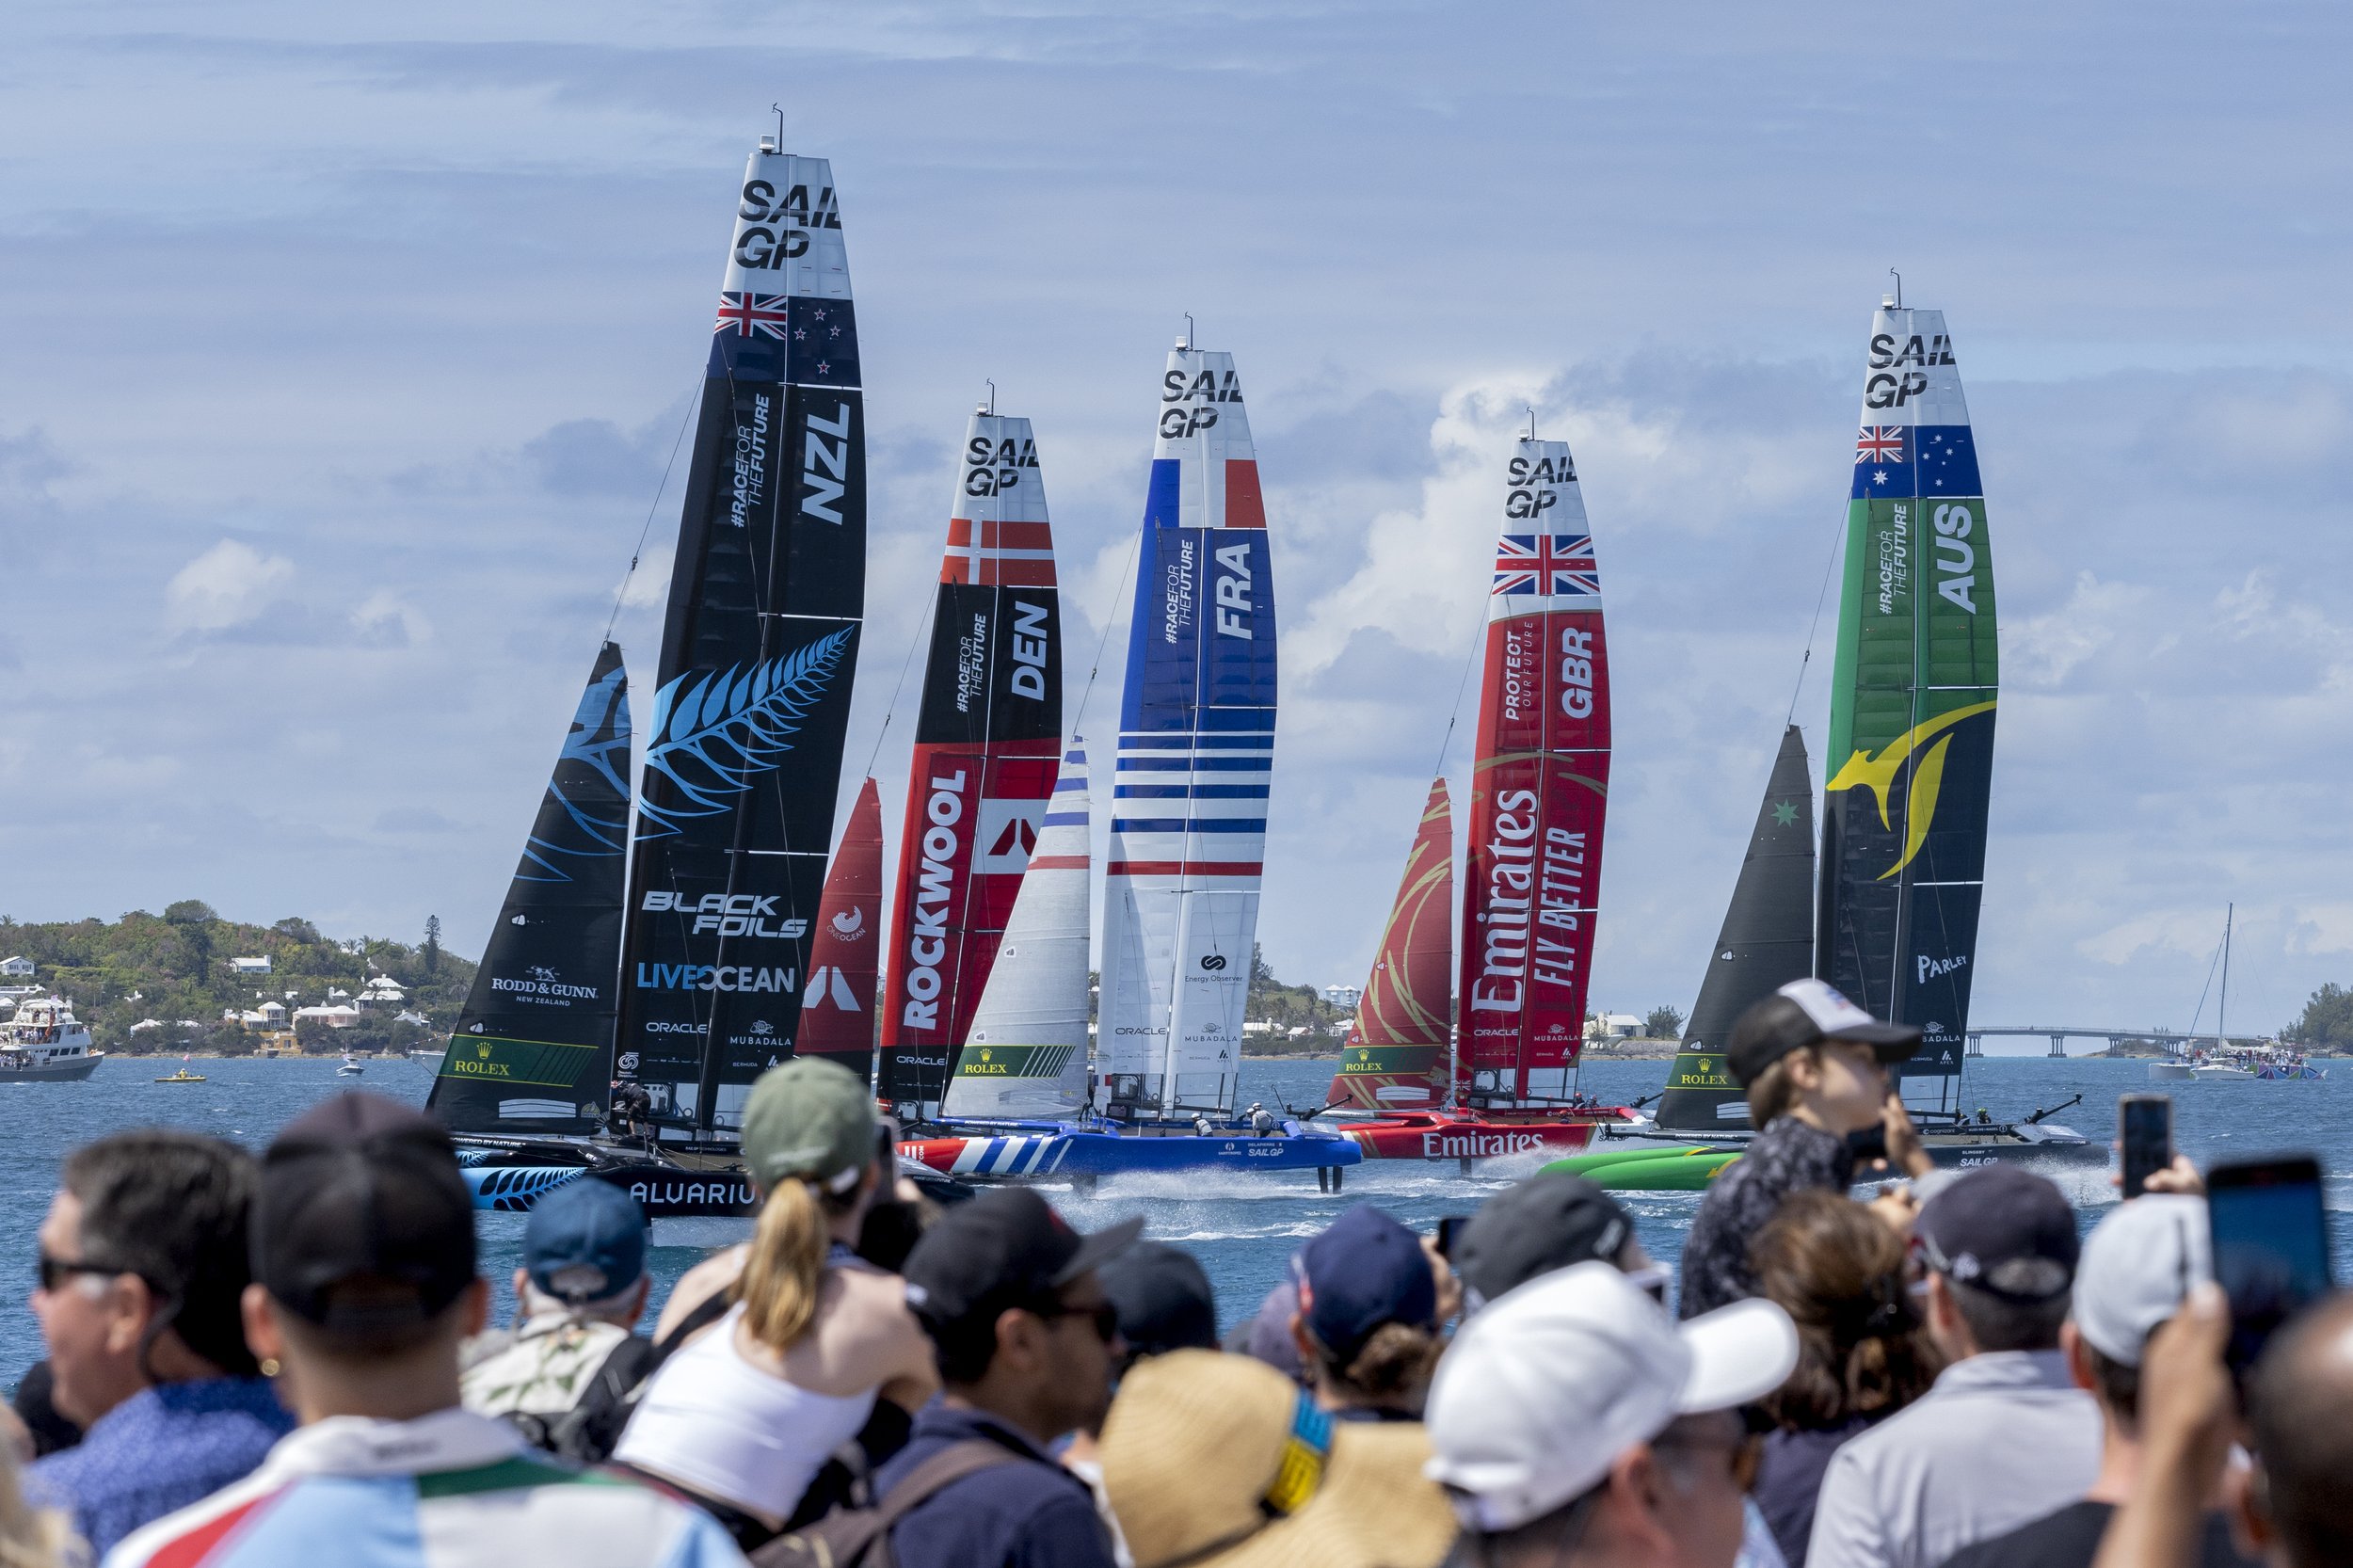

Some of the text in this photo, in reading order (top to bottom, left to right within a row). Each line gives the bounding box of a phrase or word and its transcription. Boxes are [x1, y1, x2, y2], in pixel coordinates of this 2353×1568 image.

[738, 179, 842, 230] SAIL
[734, 227, 810, 270] GP
[1867, 333, 1957, 370] SAIL
[1161, 370, 1244, 403] SAIL
[1865, 372, 1929, 409] GP
[1159, 407, 1220, 440] GP
[801, 403, 850, 525] NZL
[966, 436, 1040, 468] SAIL
[965, 468, 1019, 497] GP
[1507, 456, 1578, 487] SAIL
[1505, 489, 1558, 519] GP
[1933, 504, 1977, 615] AUS
[1215, 543, 1253, 640] FRA
[1011, 600, 1048, 701] DEN
[1522, 621, 1534, 707] OUR FUTURE
[1506, 631, 1522, 721] PROTECT
[1561, 627, 1593, 719] GBR
[642, 890, 781, 916] BLACK
[903, 770, 967, 1031] ROCKWOOL
[1471, 790, 1538, 1013] Emirates
[1533, 827, 1586, 987] FLY BETTER
[692, 915, 808, 938] FOILS
[491, 978, 598, 999] RODD & GUNN
[1185, 975, 1209, 984] Energy
[536, 998, 570, 1007] ZEALAND
[646, 1022, 708, 1033] ORACLE
[730, 1036, 792, 1046] MUBADALA
[1115, 1027, 1166, 1035] ORACLE
[454, 1060, 510, 1076] ROLEX
[896, 1055, 945, 1065] ORACLE
[965, 1064, 1007, 1073] ROLEX
[1345, 1063, 1383, 1071] ROLEX
[1681, 1074, 1728, 1085] ROLEX
[1422, 1130, 1544, 1158] Emirates
[630, 1181, 764, 1205] ALVARIU
